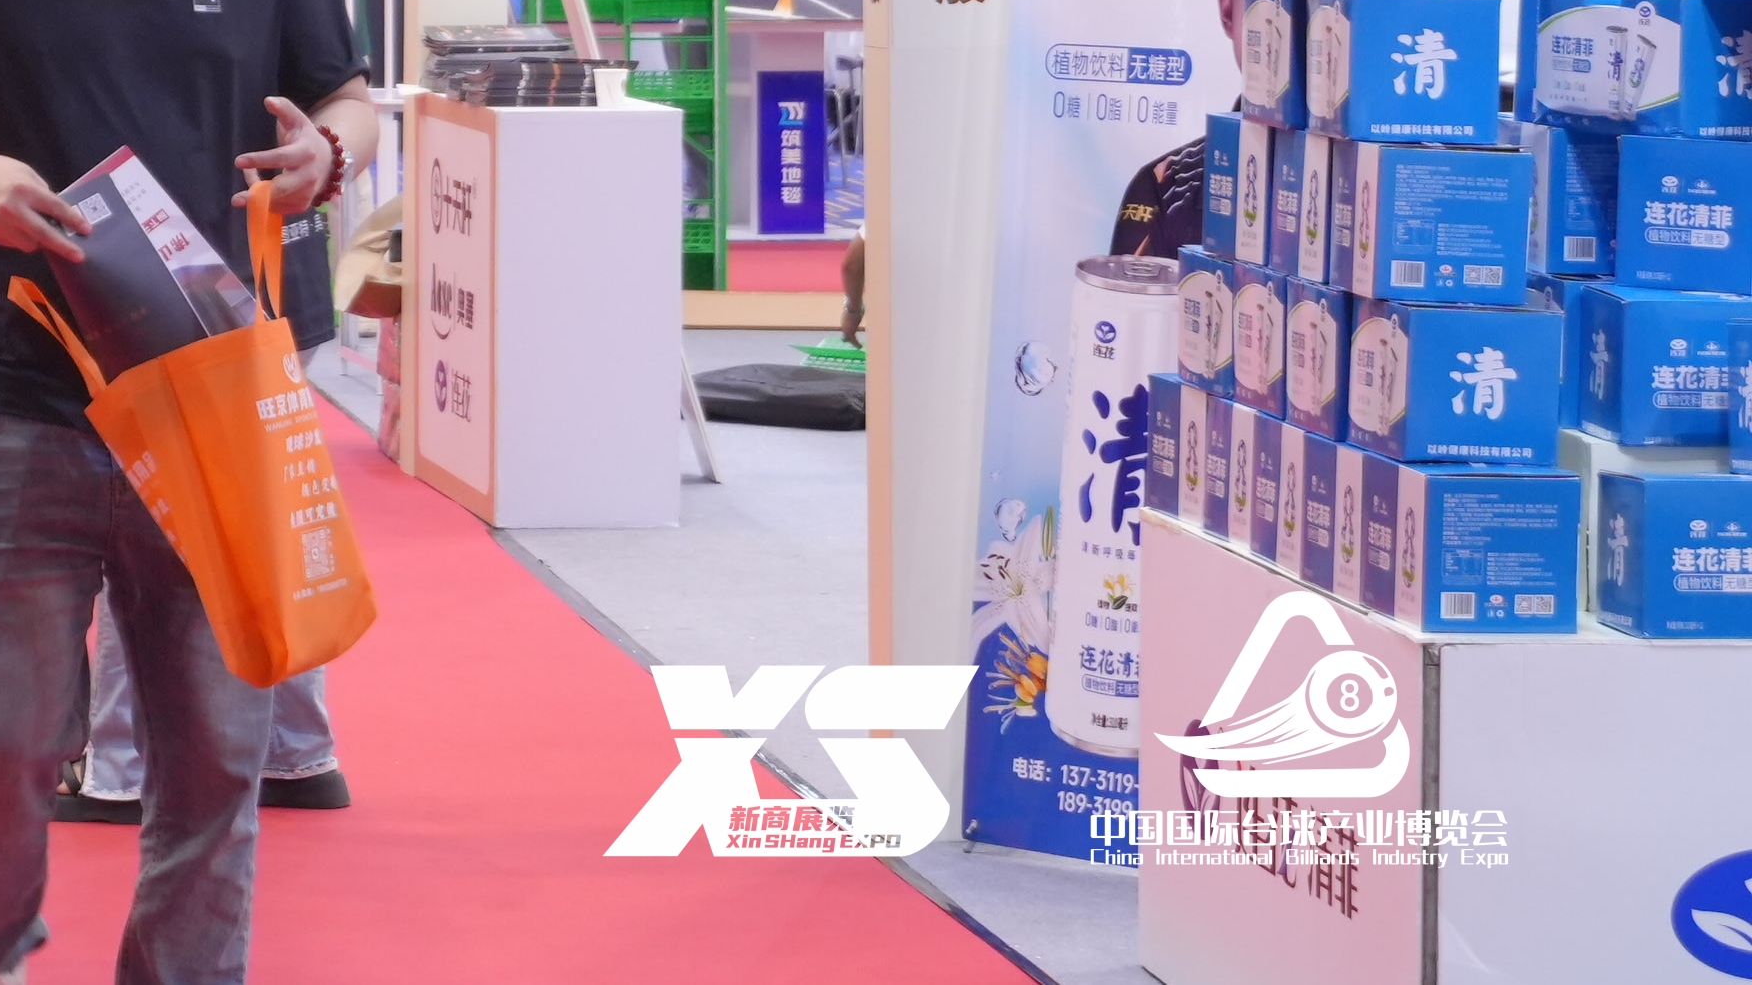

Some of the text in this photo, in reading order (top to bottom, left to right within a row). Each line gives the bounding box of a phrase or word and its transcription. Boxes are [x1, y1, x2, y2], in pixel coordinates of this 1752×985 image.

[1051, 49, 1186, 83] 植物饮料 无糖型
[1390, 28, 1458, 100] 清
[1370, 123, 1474, 136] 以岭健康科技有限公司
[780, 129, 803, 204] 筑美地毯
[1644, 201, 1733, 229] 连花清菲
[1449, 346, 1517, 420] 清
[256, 386, 314, 420] 旺京体育
[1426, 444, 1532, 459] 以岭健康科技有限公司
[1079, 645, 1139, 680] 连花清
